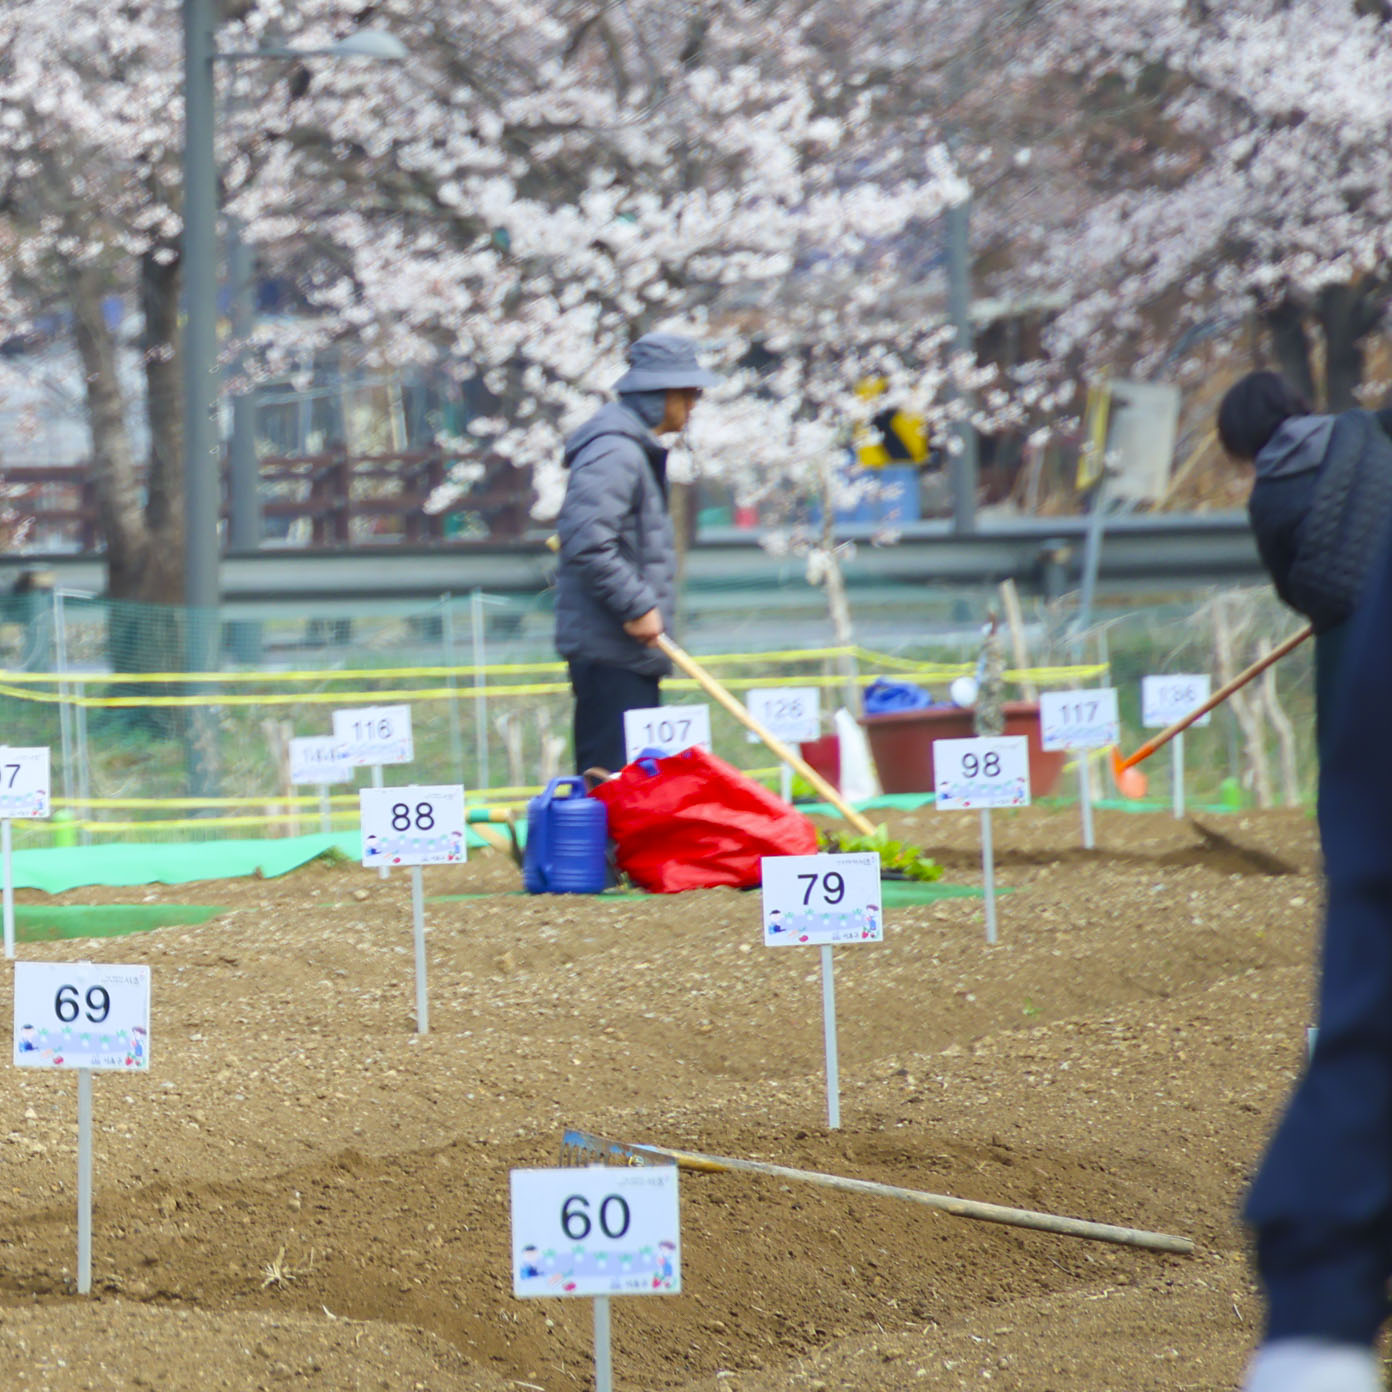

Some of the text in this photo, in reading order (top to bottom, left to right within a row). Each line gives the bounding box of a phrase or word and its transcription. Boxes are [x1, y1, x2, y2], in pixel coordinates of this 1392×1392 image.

[1059, 701, 1099, 726] 117
[644, 719, 692, 744] 107
[961, 751, 1002, 779] 98
[392, 802, 435, 832] 88
[797, 871, 845, 906] 79
[54, 983, 111, 1024] 69
[560, 1193, 632, 1240] 60
